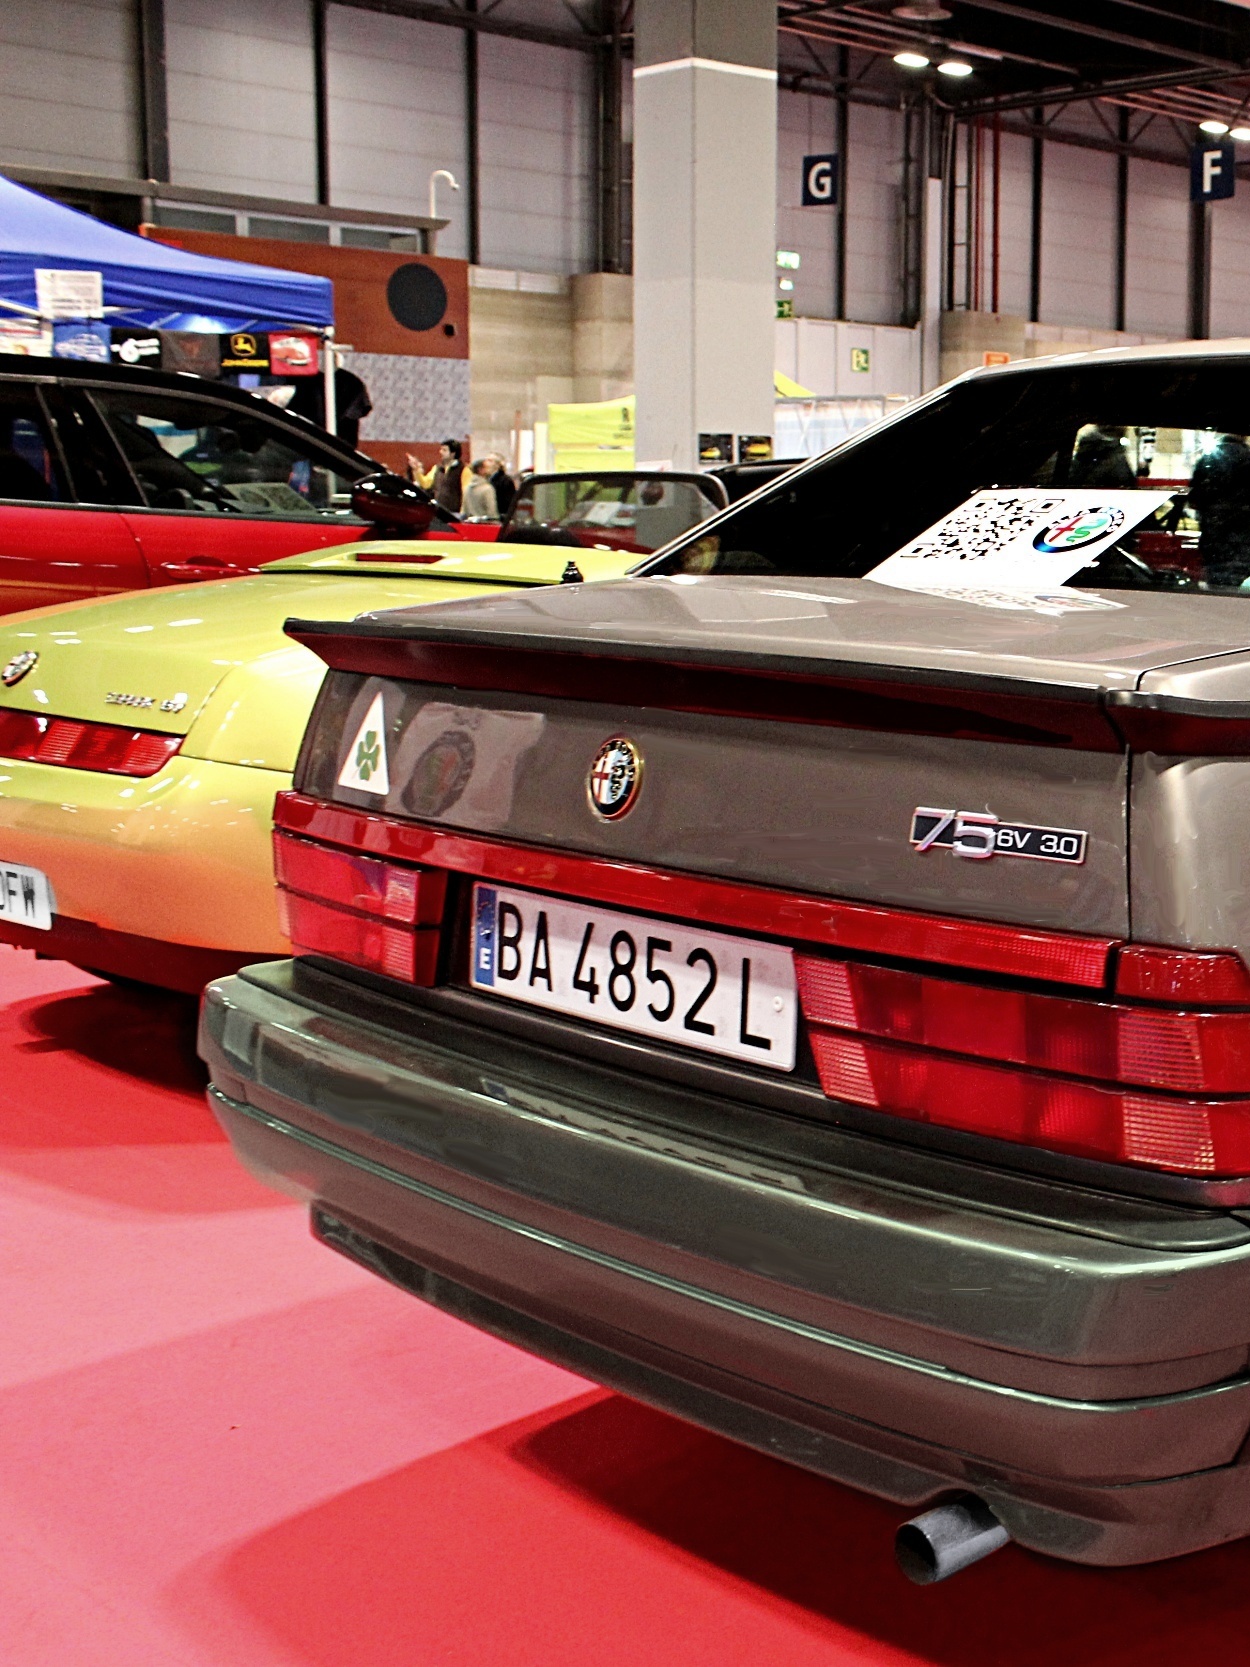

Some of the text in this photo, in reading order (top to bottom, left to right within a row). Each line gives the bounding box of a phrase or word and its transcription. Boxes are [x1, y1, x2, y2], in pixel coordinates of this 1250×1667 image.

[808, 162, 832, 199] G
[1203, 150, 1222, 193] F
[914, 806, 1078, 859] 75 6V 3.0
[479, 948, 492, 971] E
[498, 901, 772, 1051] BA 4852 L
